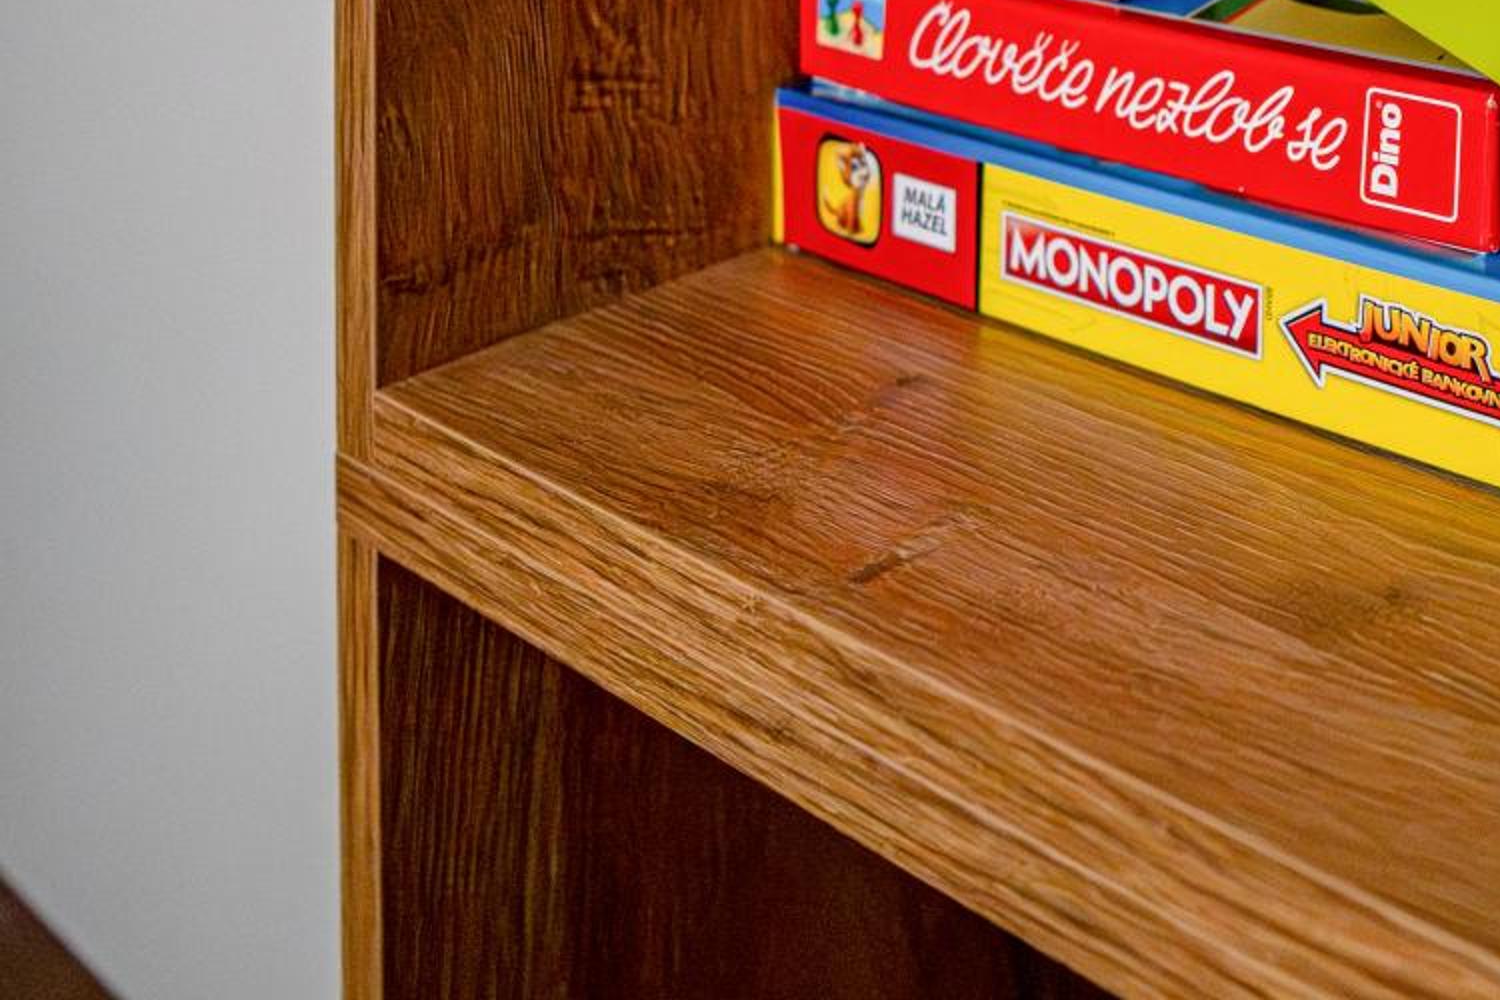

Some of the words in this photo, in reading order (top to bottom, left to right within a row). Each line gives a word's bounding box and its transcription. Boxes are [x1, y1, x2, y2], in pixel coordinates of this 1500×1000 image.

[908, 0, 1094, 108] Člověče
[1095, 66, 1296, 153] nezlob
[1286, 106, 1349, 171] se
[1370, 102, 1403, 199] Dino
[901, 207, 949, 239] HAZEL
[903, 184, 946, 214] MALÁ
[1008, 233, 1254, 341] MONOPOLY
[1307, 332, 1419, 379] ELEKTRONICKÉ
[1359, 300, 1491, 382] JUNIOR
